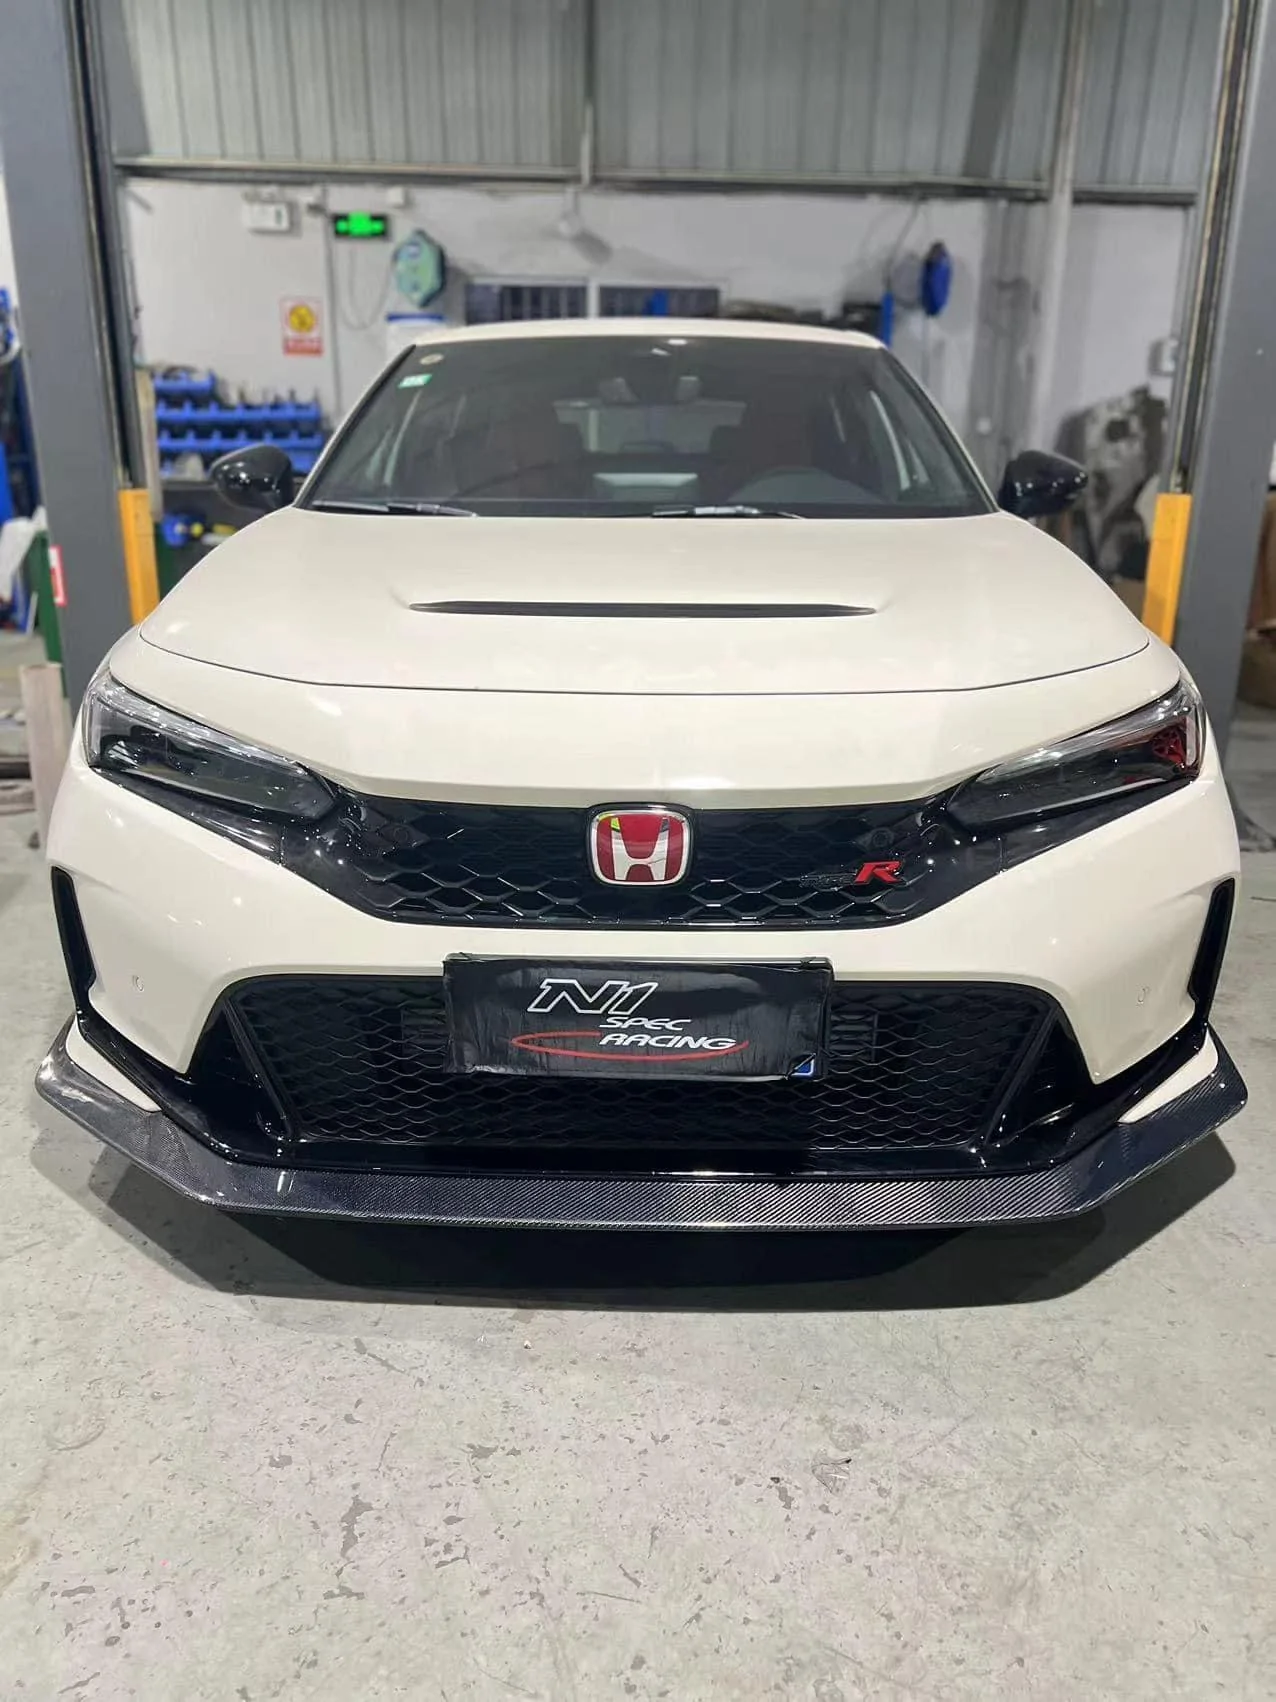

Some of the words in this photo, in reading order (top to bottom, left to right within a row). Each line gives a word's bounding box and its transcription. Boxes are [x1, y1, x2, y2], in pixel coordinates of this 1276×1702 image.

[853, 860, 900, 885] R
[527, 978, 659, 1015] N1
[600, 1016, 692, 1031] SPEC
[599, 1033, 737, 1050] RACING
